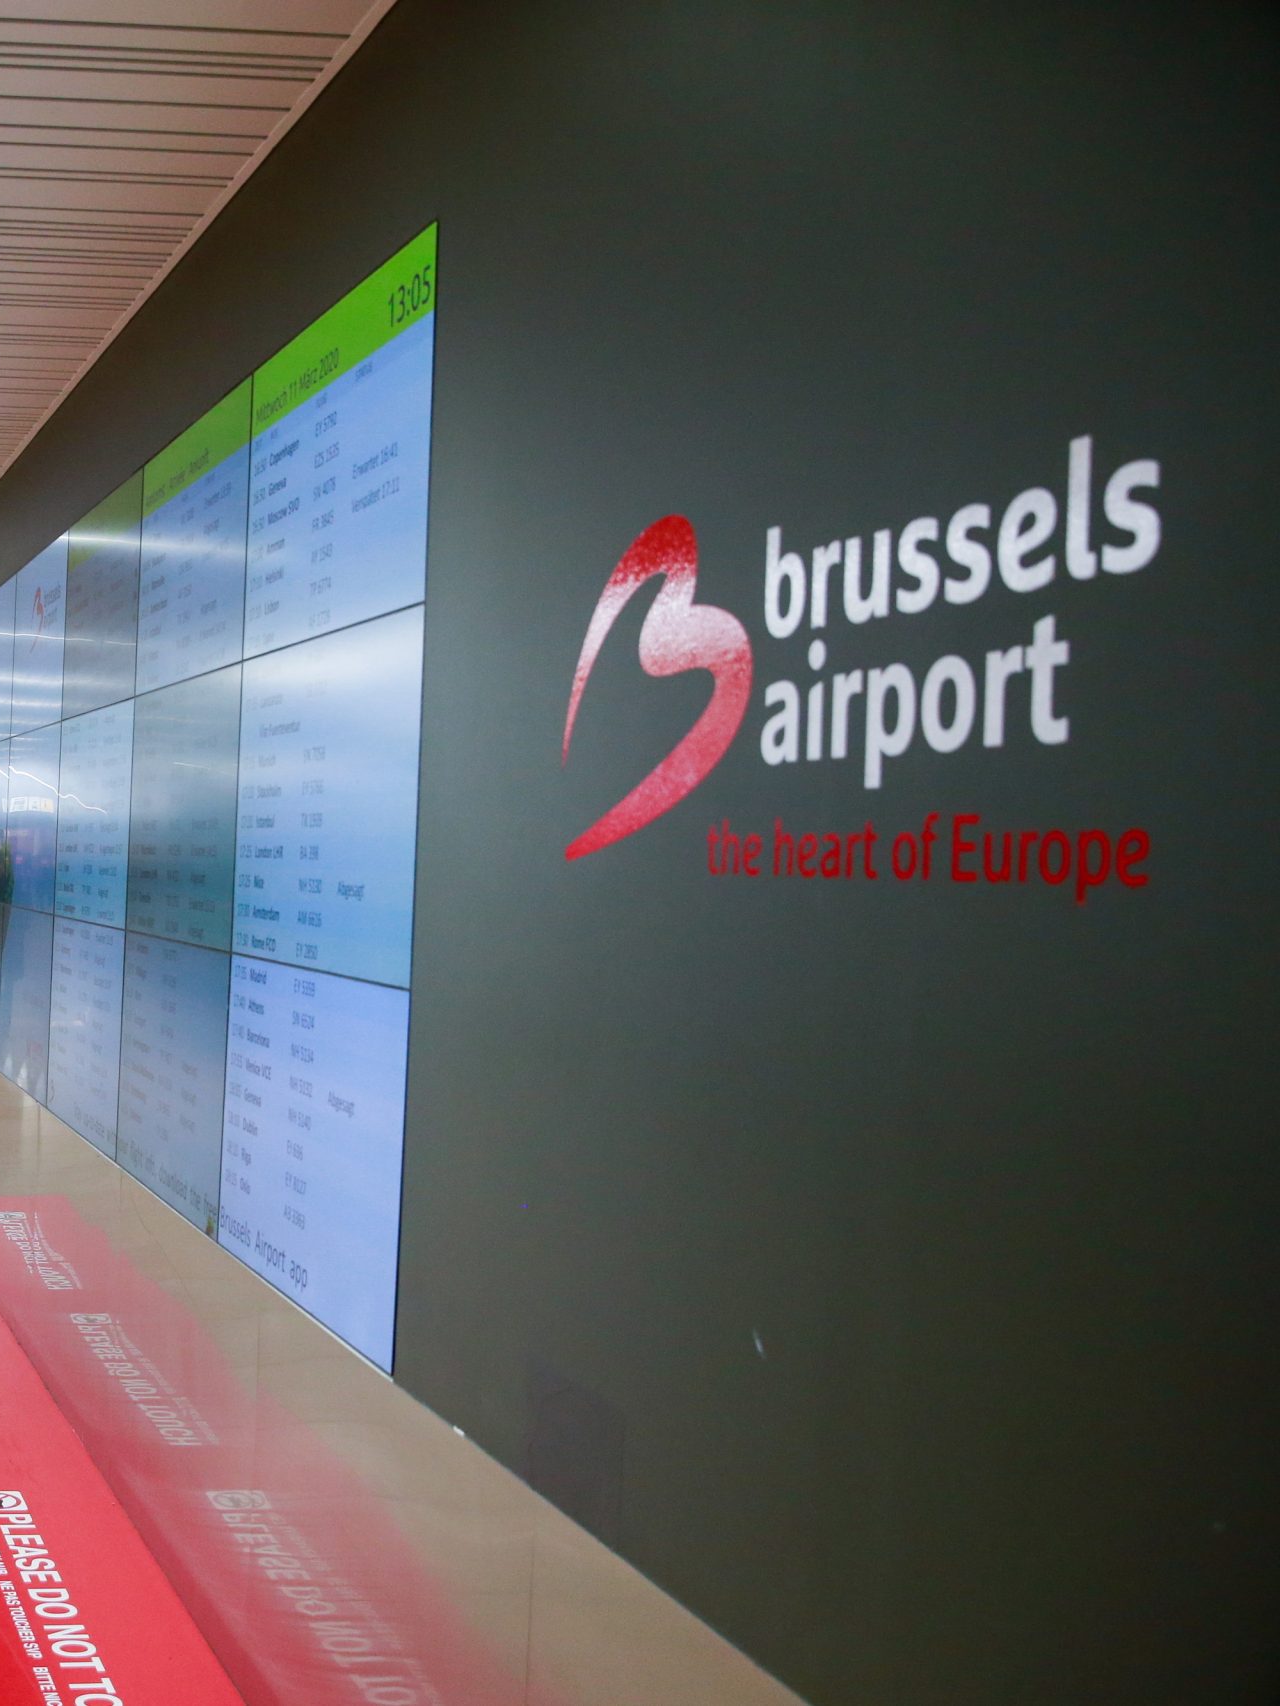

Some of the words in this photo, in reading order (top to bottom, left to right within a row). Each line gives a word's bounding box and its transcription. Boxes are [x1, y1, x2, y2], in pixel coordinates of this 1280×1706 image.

[388, 264, 431, 328] 13:05
[289, 380, 297, 400] 11
[319, 346, 339, 380] 2020
[269, 439, 300, 467] Copenhagen
[268, 477, 287, 497] Geneva
[267, 507, 287, 526] Moscow
[764, 432, 1164, 639] brussels
[760, 614, 1070, 789] airport
[707, 818, 761, 876] the
[773, 817, 877, 880] heart
[891, 811, 939, 880] of
[951, 812, 1150, 905] Europe
[252, 904, 280, 922] Amsterdam
[249, 967, 267, 986] Madrid
[248, 998, 265, 1016] Athens
[246, 1027, 270, 1049] Barcelona
[245, 1056, 261, 1076] Venice
[243, 1087, 262, 1108] Geneva
[242, 1117, 258, 1137] Dublin
[240, 1146, 252, 1167] Riga
[239, 1176, 251, 1196] Oslo
[220, 1205, 251, 1250] Brussels
[254, 1229, 286, 1274] Airport
[289, 1257, 308, 1293] app
[3, 1591, 20, 1605] PAS
[28, 1588, 78, 1618] DO
[9, 1606, 36, 1642] TOUCHER
[23, 1641, 43, 1659] SVP
[43, 1624, 106, 1673] NOT
[33, 1666, 57, 1691] BITTE
